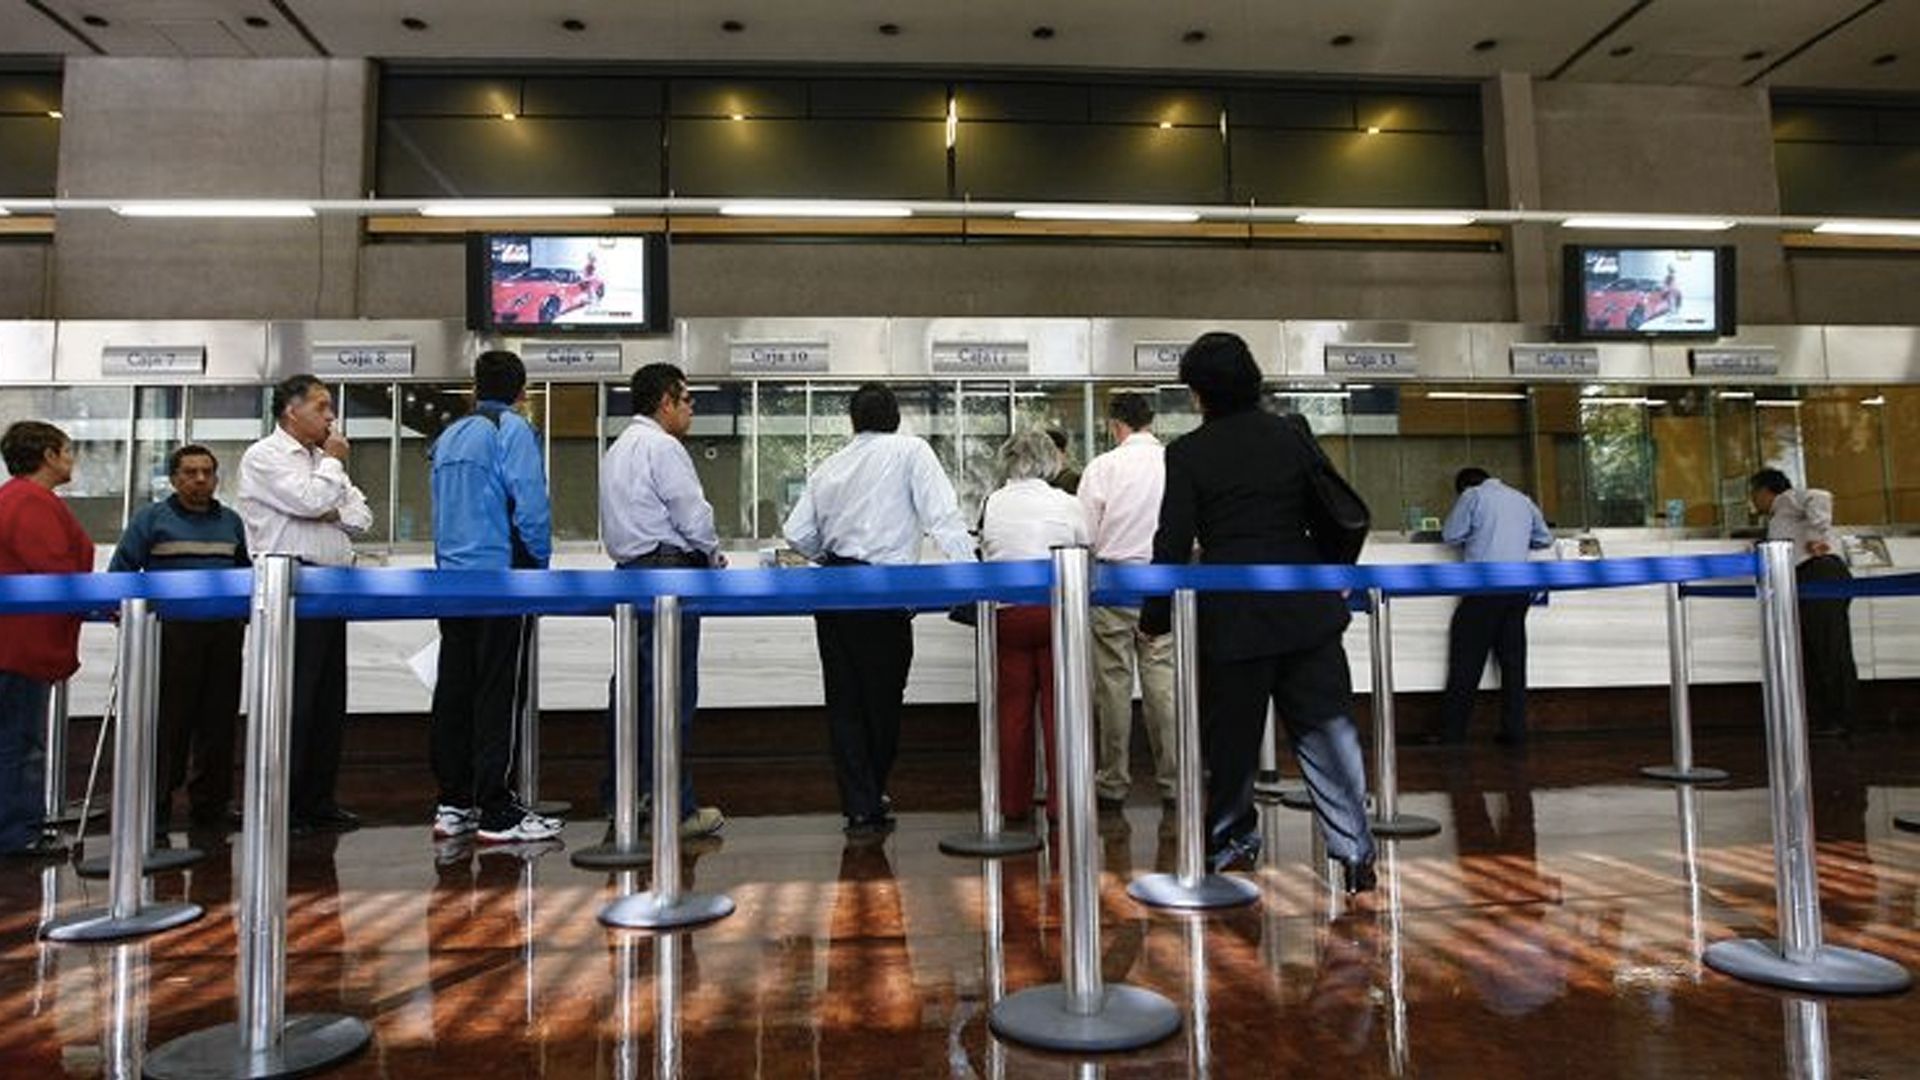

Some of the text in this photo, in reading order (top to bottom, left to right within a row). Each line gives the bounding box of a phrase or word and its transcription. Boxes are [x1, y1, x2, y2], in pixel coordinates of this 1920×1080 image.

[127, 352, 176, 367] Caja 7
[338, 350, 387, 367] Caja 8
[546, 347, 595, 365] Caja 9
[751, 347, 809, 366] Caja 10
[959, 347, 992, 366] Caja
[1344, 351, 1377, 369] Caja
